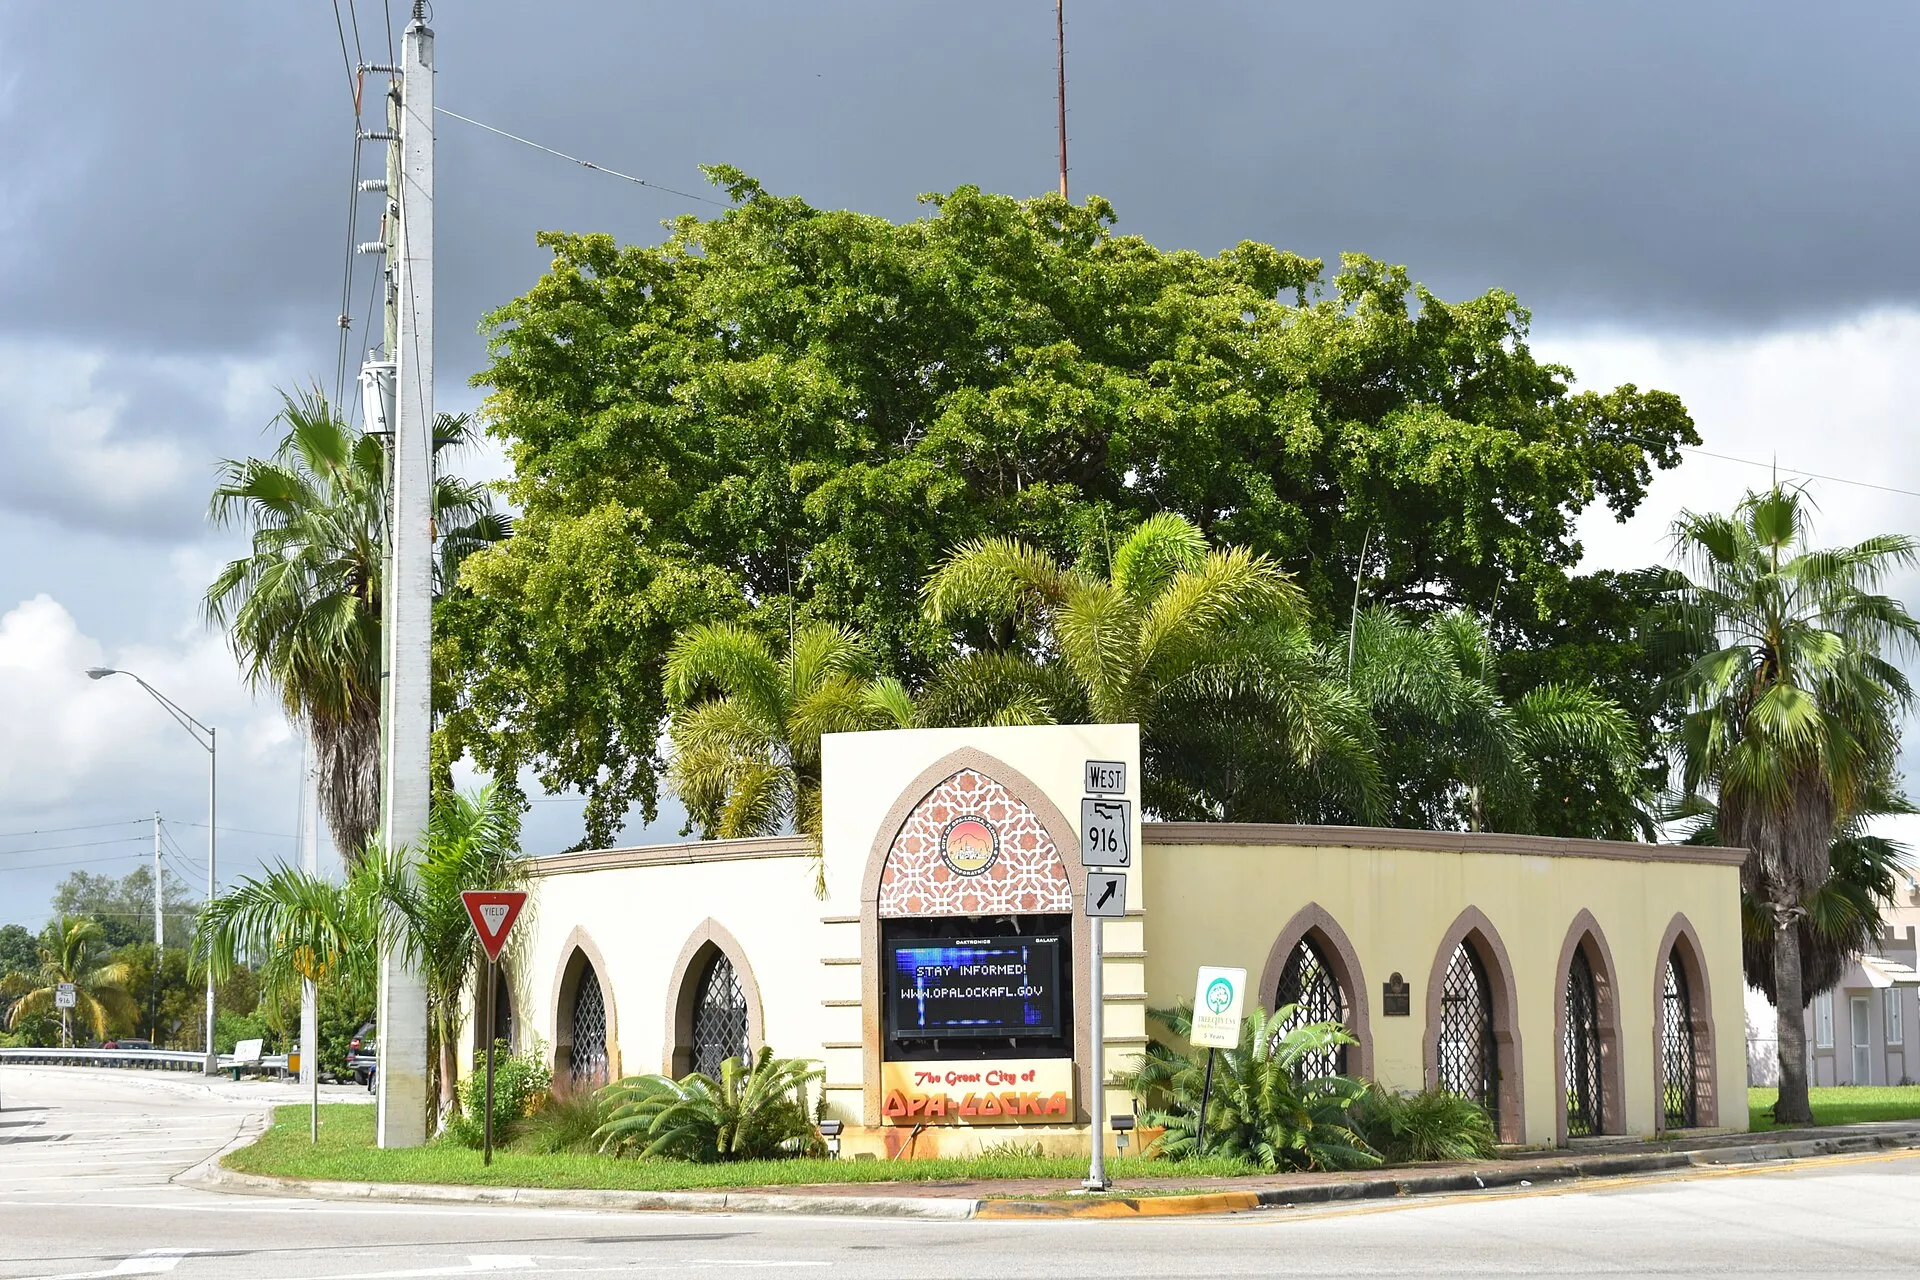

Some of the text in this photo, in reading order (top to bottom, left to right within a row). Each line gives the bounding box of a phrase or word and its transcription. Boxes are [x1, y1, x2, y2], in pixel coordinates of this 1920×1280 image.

[1090, 766, 1121, 789] WEST
[945, 825, 952, 835] OF
[985, 823, 999, 848] FLORIDA
[1089, 826, 1117, 852] 916
[944, 857, 986, 876] INCORPORATED
[484, 907, 505, 916] YIELD
[916, 964, 1027, 977] STAY INFORMED!
[901, 986, 1043, 999] WWW.OPALOCKAFL.GOV
[914, 1069, 1036, 1087] The Great City of
[882, 1088, 1067, 1117] OPA-LOCKA
